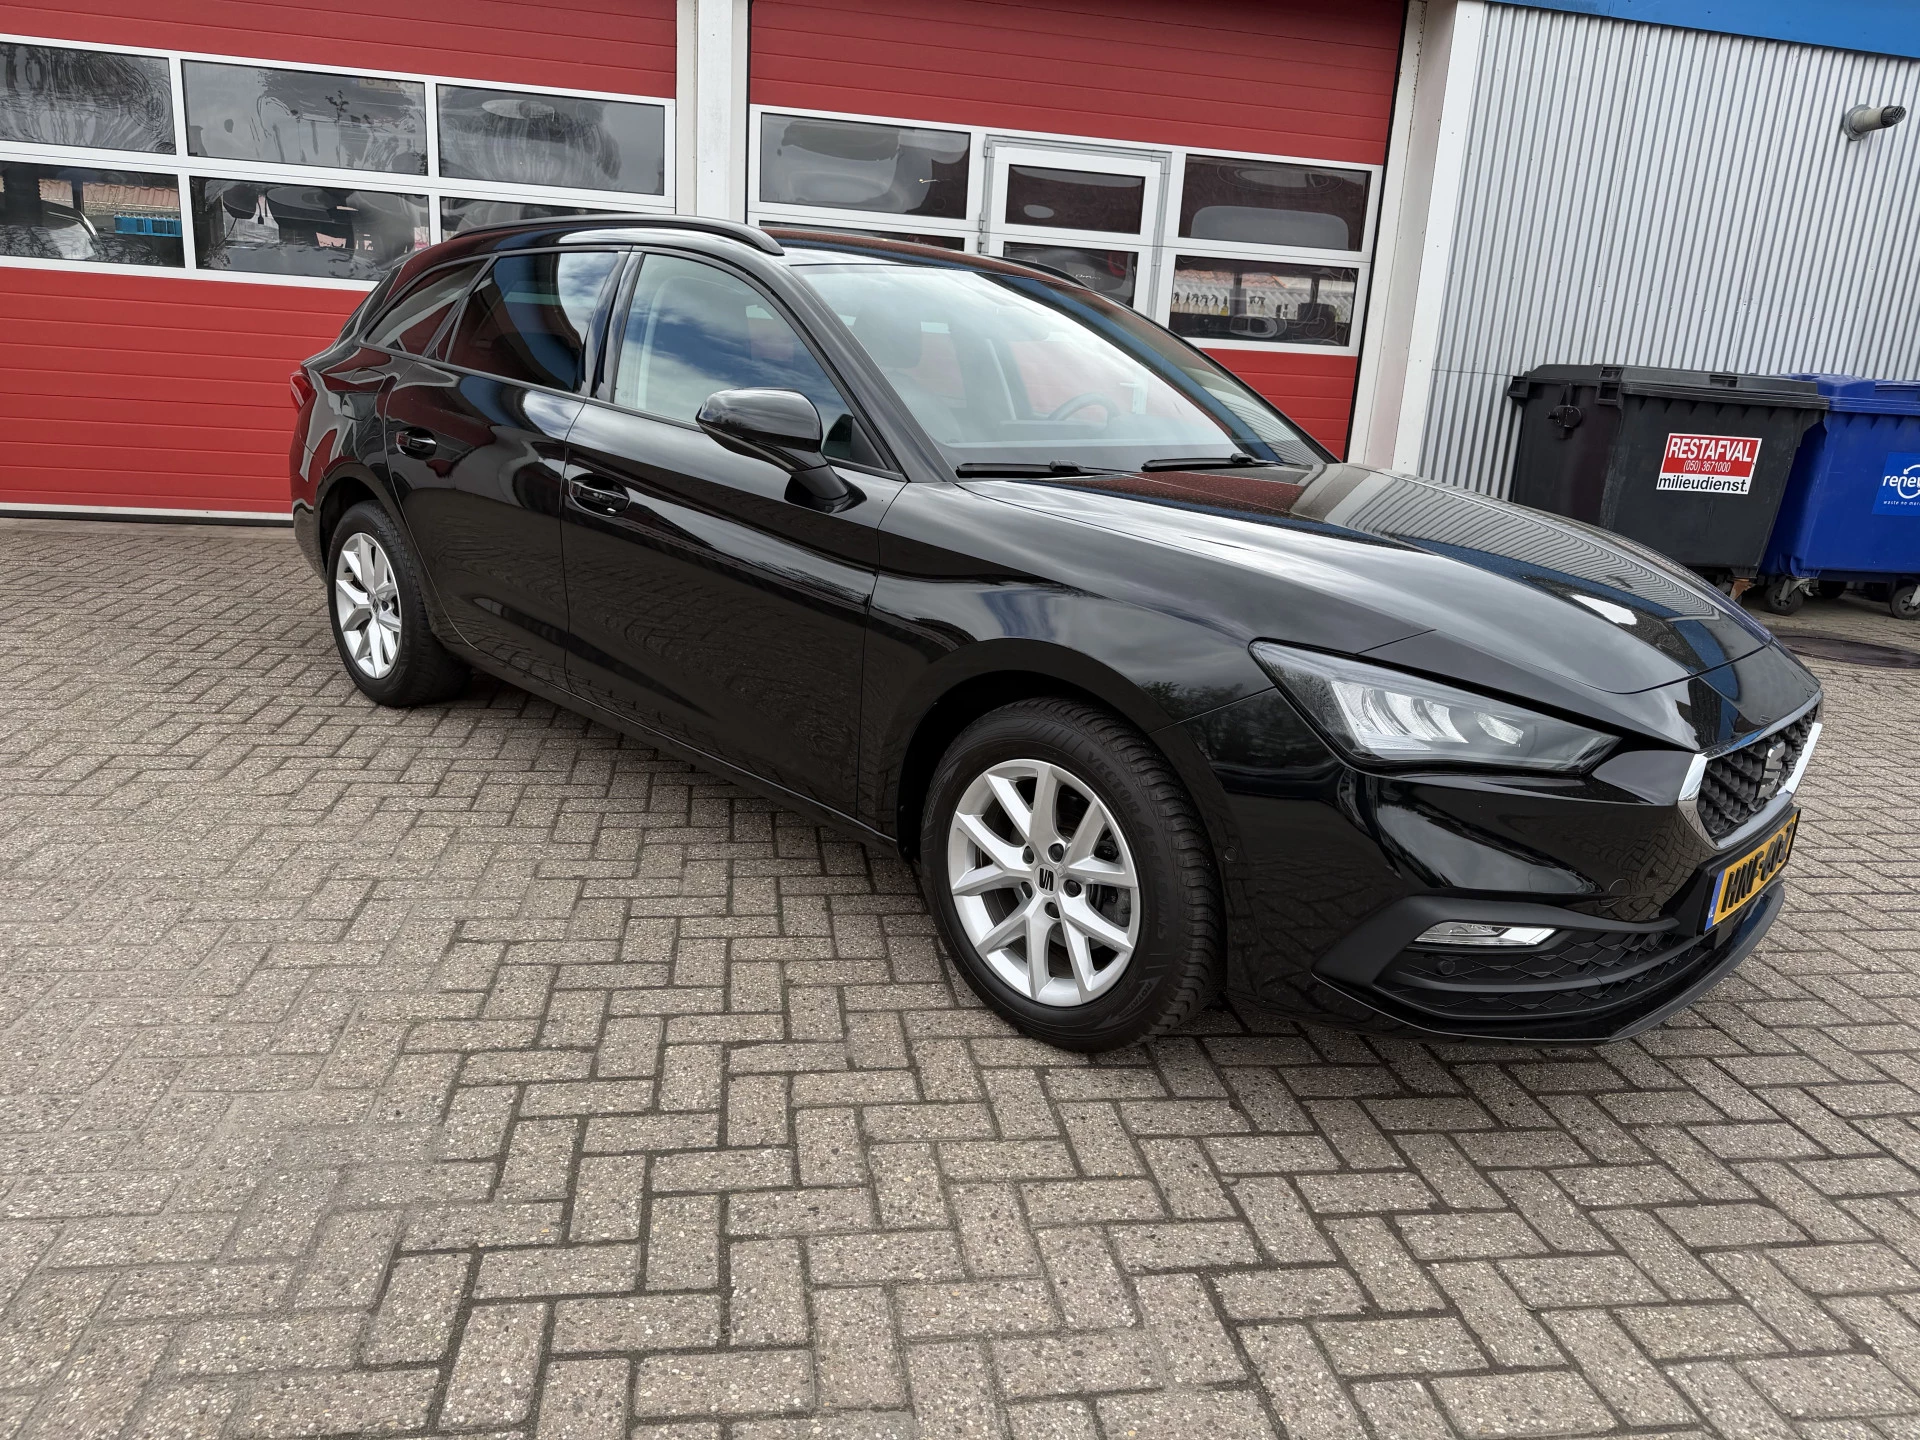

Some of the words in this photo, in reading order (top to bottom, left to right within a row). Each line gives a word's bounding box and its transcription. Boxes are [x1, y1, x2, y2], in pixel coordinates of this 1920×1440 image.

[1668, 438, 1752, 462] RESTAFVAL
[1683, 460, 1701, 473] (050)
[1702, 461, 1732, 473] 3671000
[1658, 475, 1748, 492] milieudienst.
[1086, 751, 1142, 816] VECTOR
